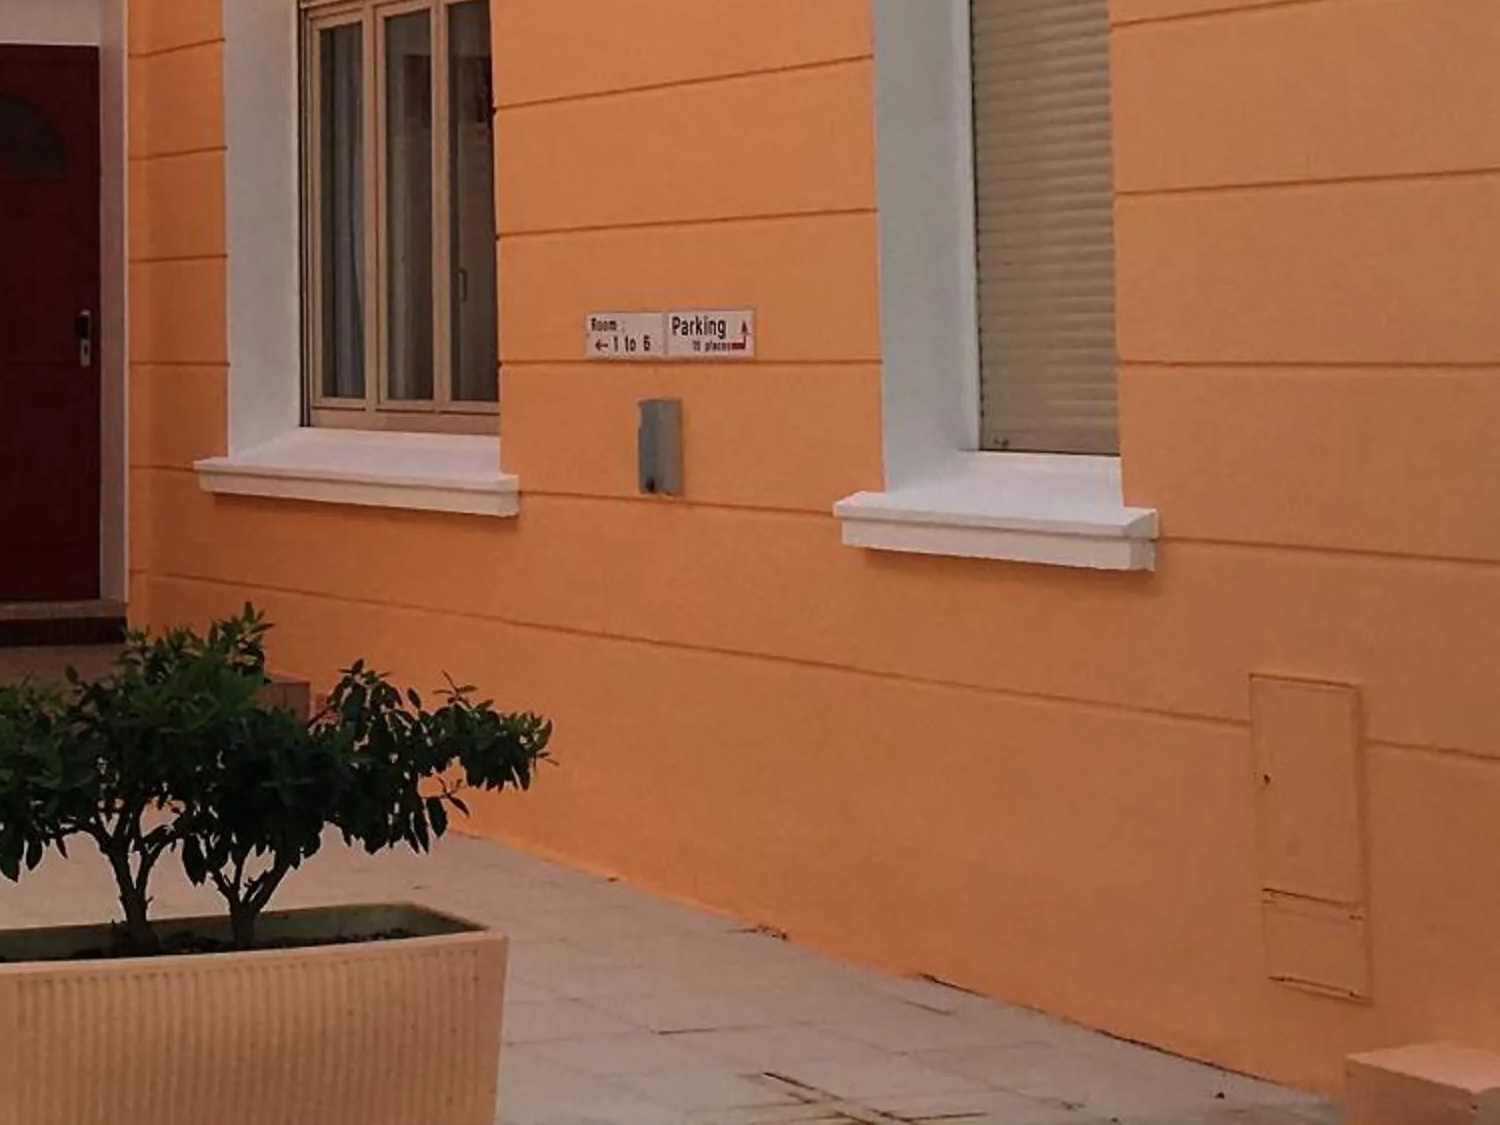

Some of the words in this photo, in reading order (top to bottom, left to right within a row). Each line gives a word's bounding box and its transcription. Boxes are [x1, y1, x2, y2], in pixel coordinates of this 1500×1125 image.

[672, 315, 726, 339] Parking
[613, 335, 619, 352] 1
[625, 335, 637, 352] to
